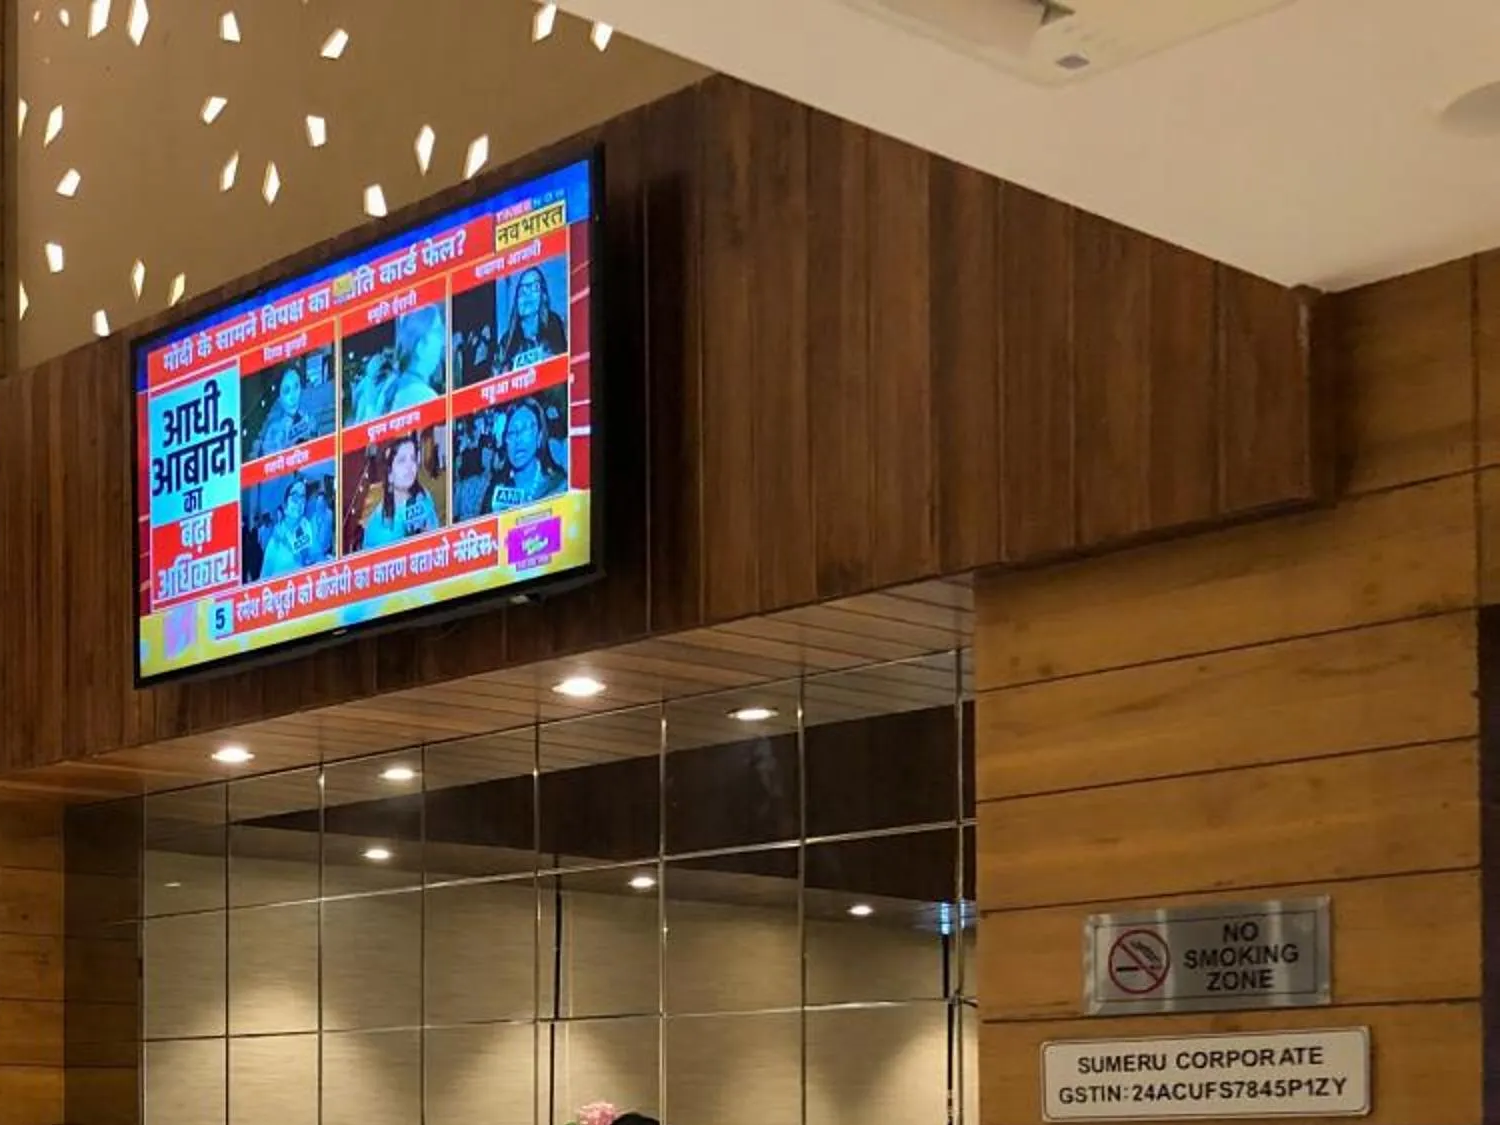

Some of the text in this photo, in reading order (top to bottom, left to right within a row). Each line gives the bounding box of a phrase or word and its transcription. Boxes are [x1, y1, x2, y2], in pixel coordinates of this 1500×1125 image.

[163, 333, 193, 372] मोदी
[197, 331, 212, 358] के
[216, 312, 257, 350] सामने
[261, 297, 304, 333] विपक्ष
[308, 288, 330, 313] का
[380, 243, 418, 284] कार्ड
[422, 229, 466, 266] फेल?
[162, 379, 221, 449] आधी
[152, 417, 238, 497] आबादी
[182, 487, 204, 514] का
[158, 549, 237, 599] अधिकार!
[214, 606, 226, 630] 5
[1223, 922, 1259, 943] NO
[1183, 943, 1299, 970] SMOKING
[1206, 969, 1274, 992] ZONE
[1077, 1045, 1324, 1075] SUMERU CORPORATE
